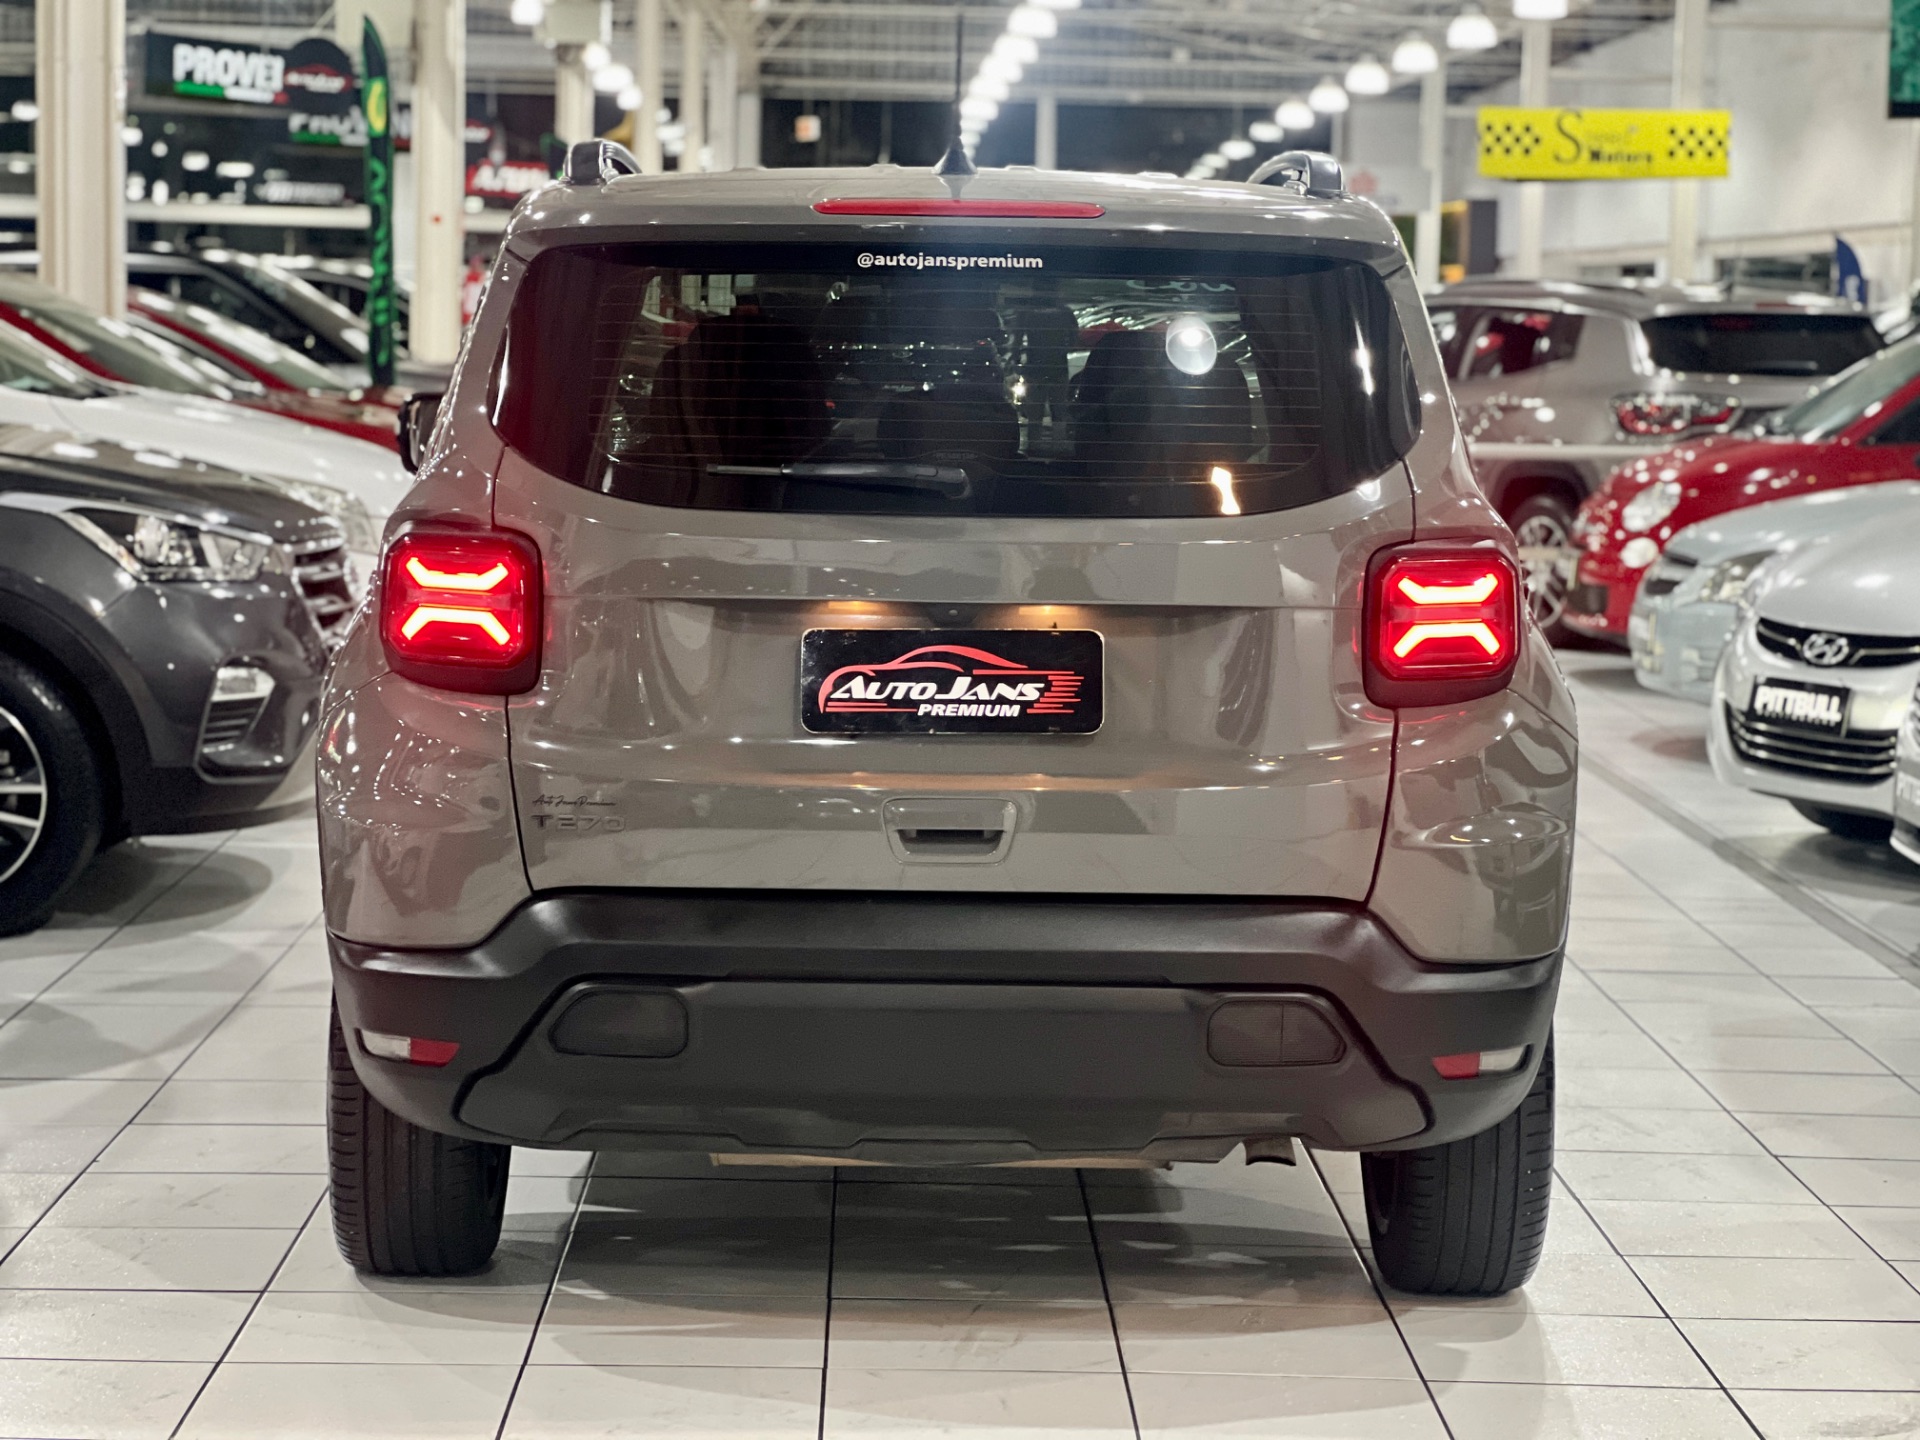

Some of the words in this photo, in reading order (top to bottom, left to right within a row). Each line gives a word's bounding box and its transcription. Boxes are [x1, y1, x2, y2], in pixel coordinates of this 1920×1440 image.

[857, 252, 1043, 270] @autojanspremium
[830, 675, 937, 700] AUTO
[940, 676, 1044, 701] JANS
[917, 704, 1020, 717] PREMIUM
[1754, 685, 1842, 723] PITTBULL
[531, 814, 625, 832] T270
